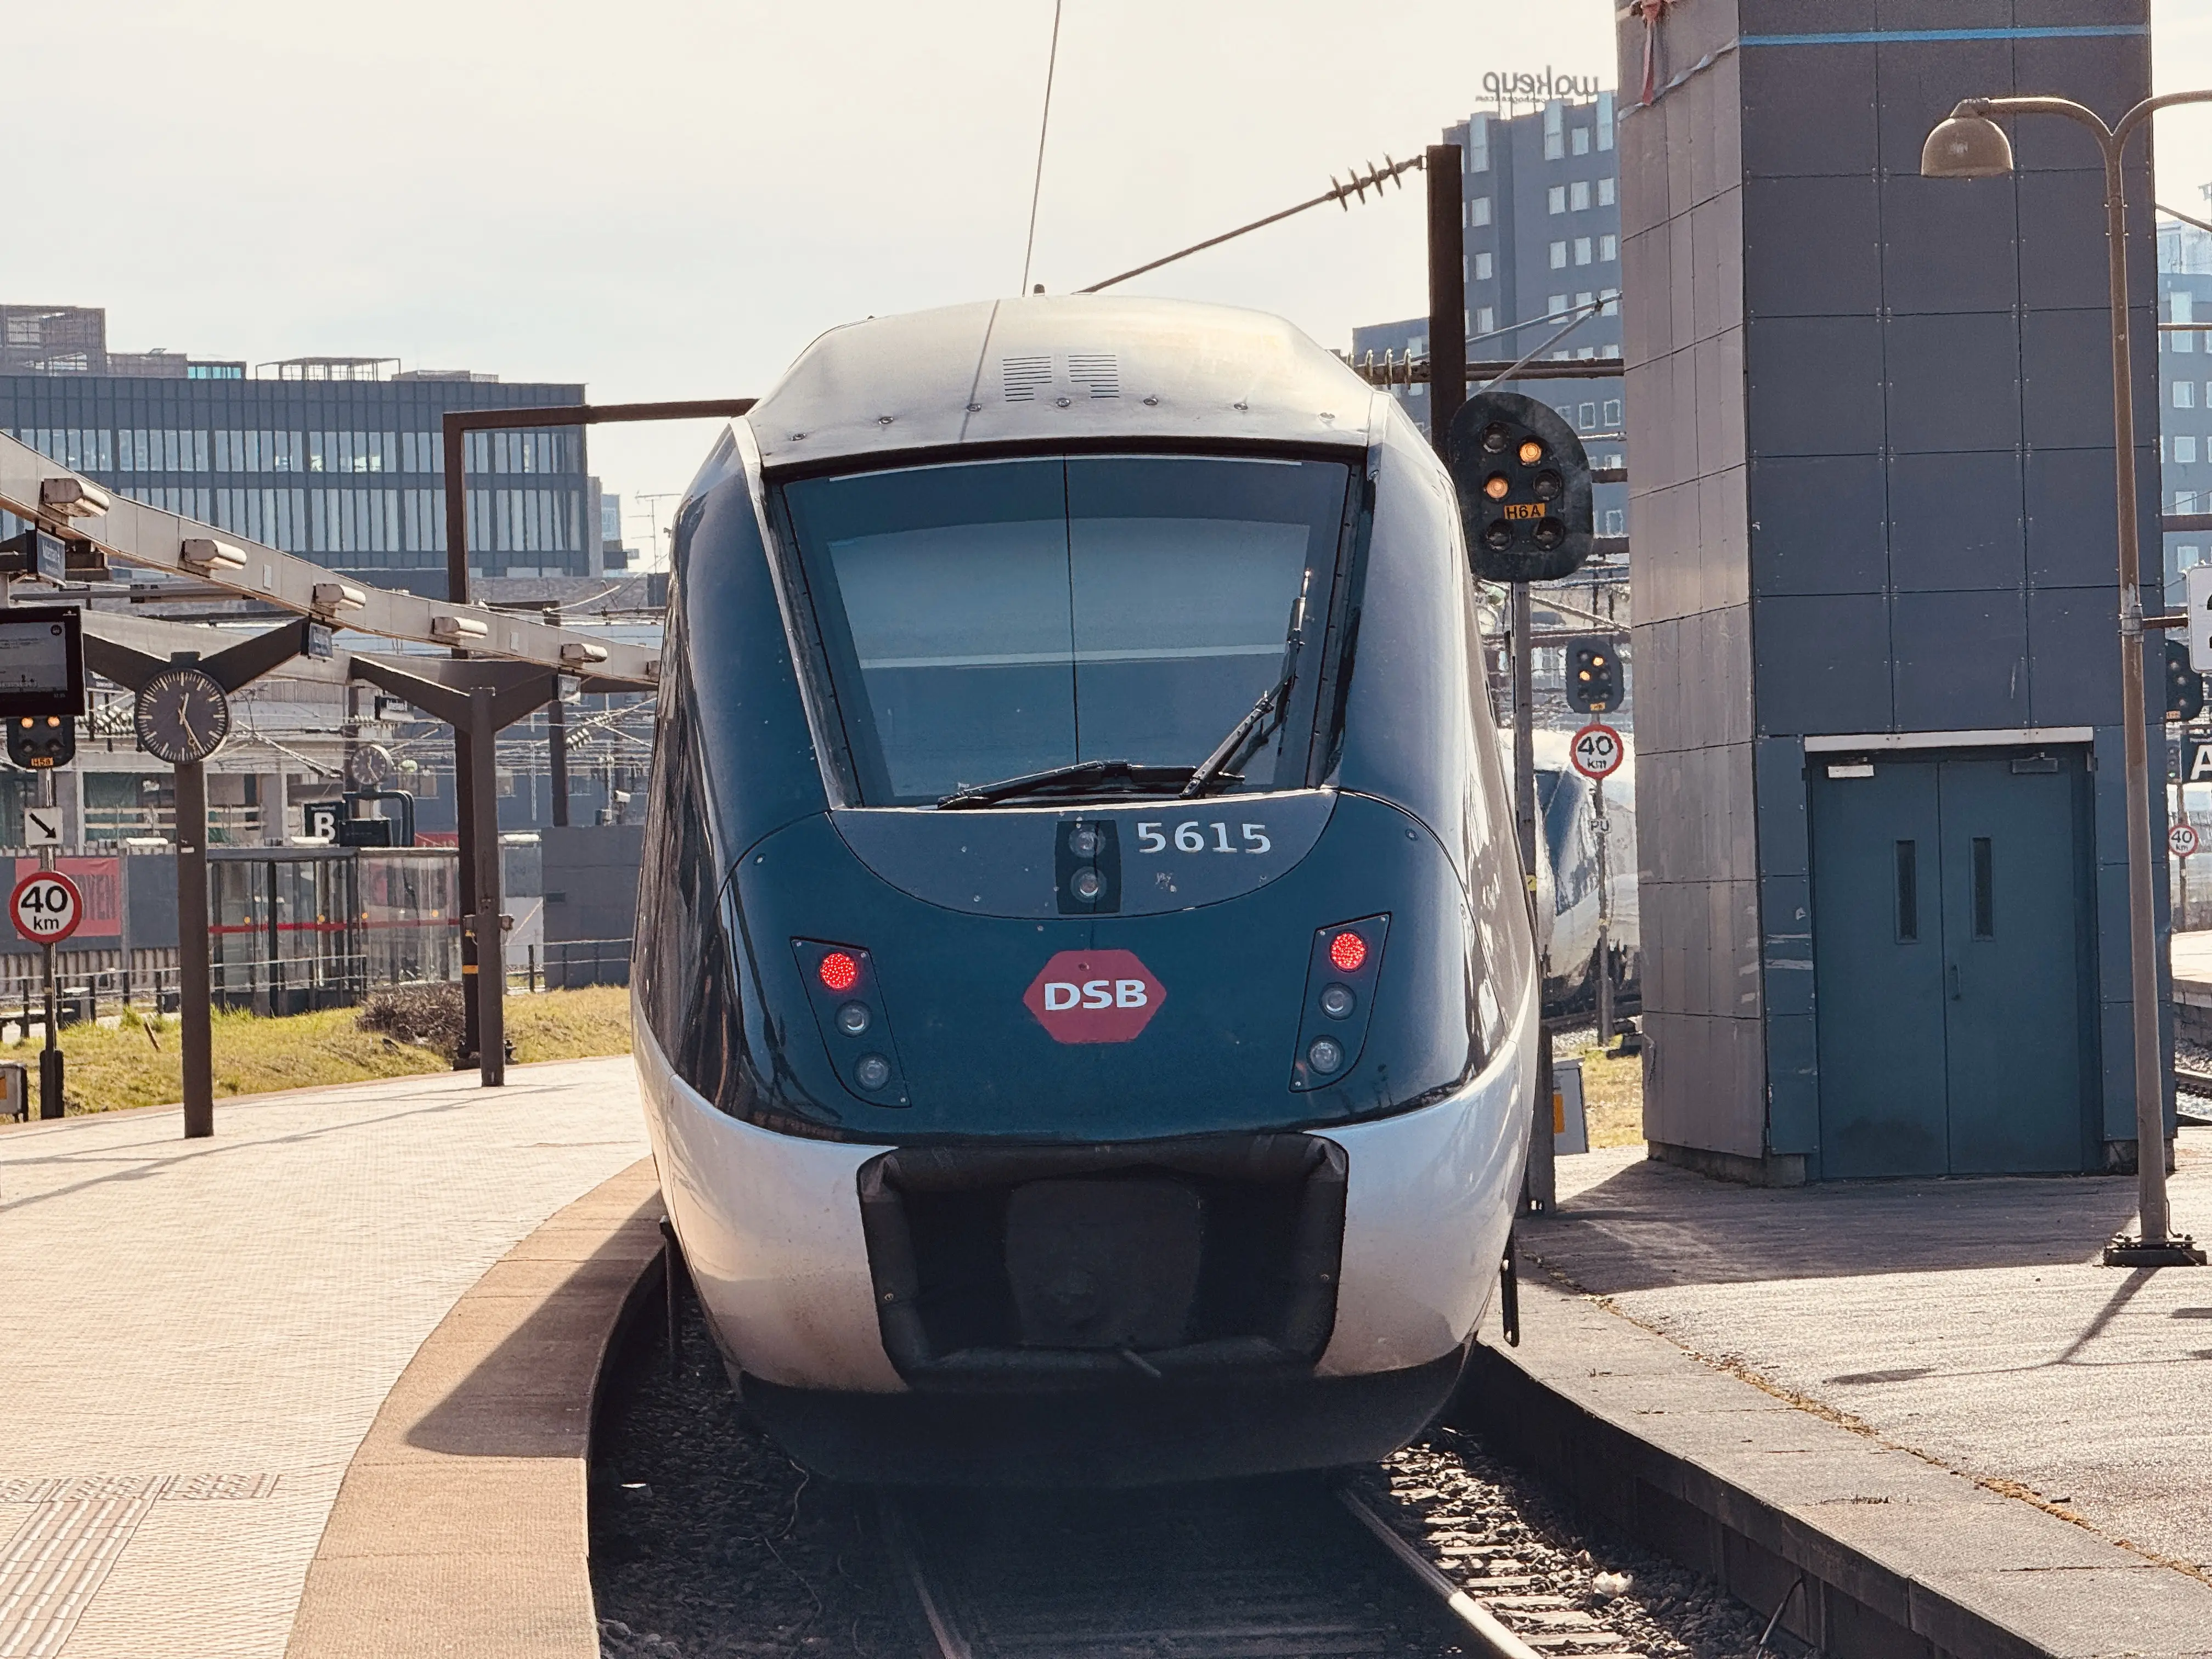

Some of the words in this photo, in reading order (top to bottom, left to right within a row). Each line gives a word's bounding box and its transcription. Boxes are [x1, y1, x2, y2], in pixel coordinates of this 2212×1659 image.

[1506, 504, 1541, 519] H6A
[1577, 736, 1614, 756] 40
[1587, 758, 1607, 769] km
[2190, 744, 2212, 780] A
[314, 812, 335, 840] B
[1590, 820, 1609, 831] PU
[1137, 821, 1271, 854] 5615
[2171, 831, 2193, 843] 40
[21, 885, 68, 913] 40
[33, 916, 59, 930] km
[1044, 979, 1148, 1011] DSB
